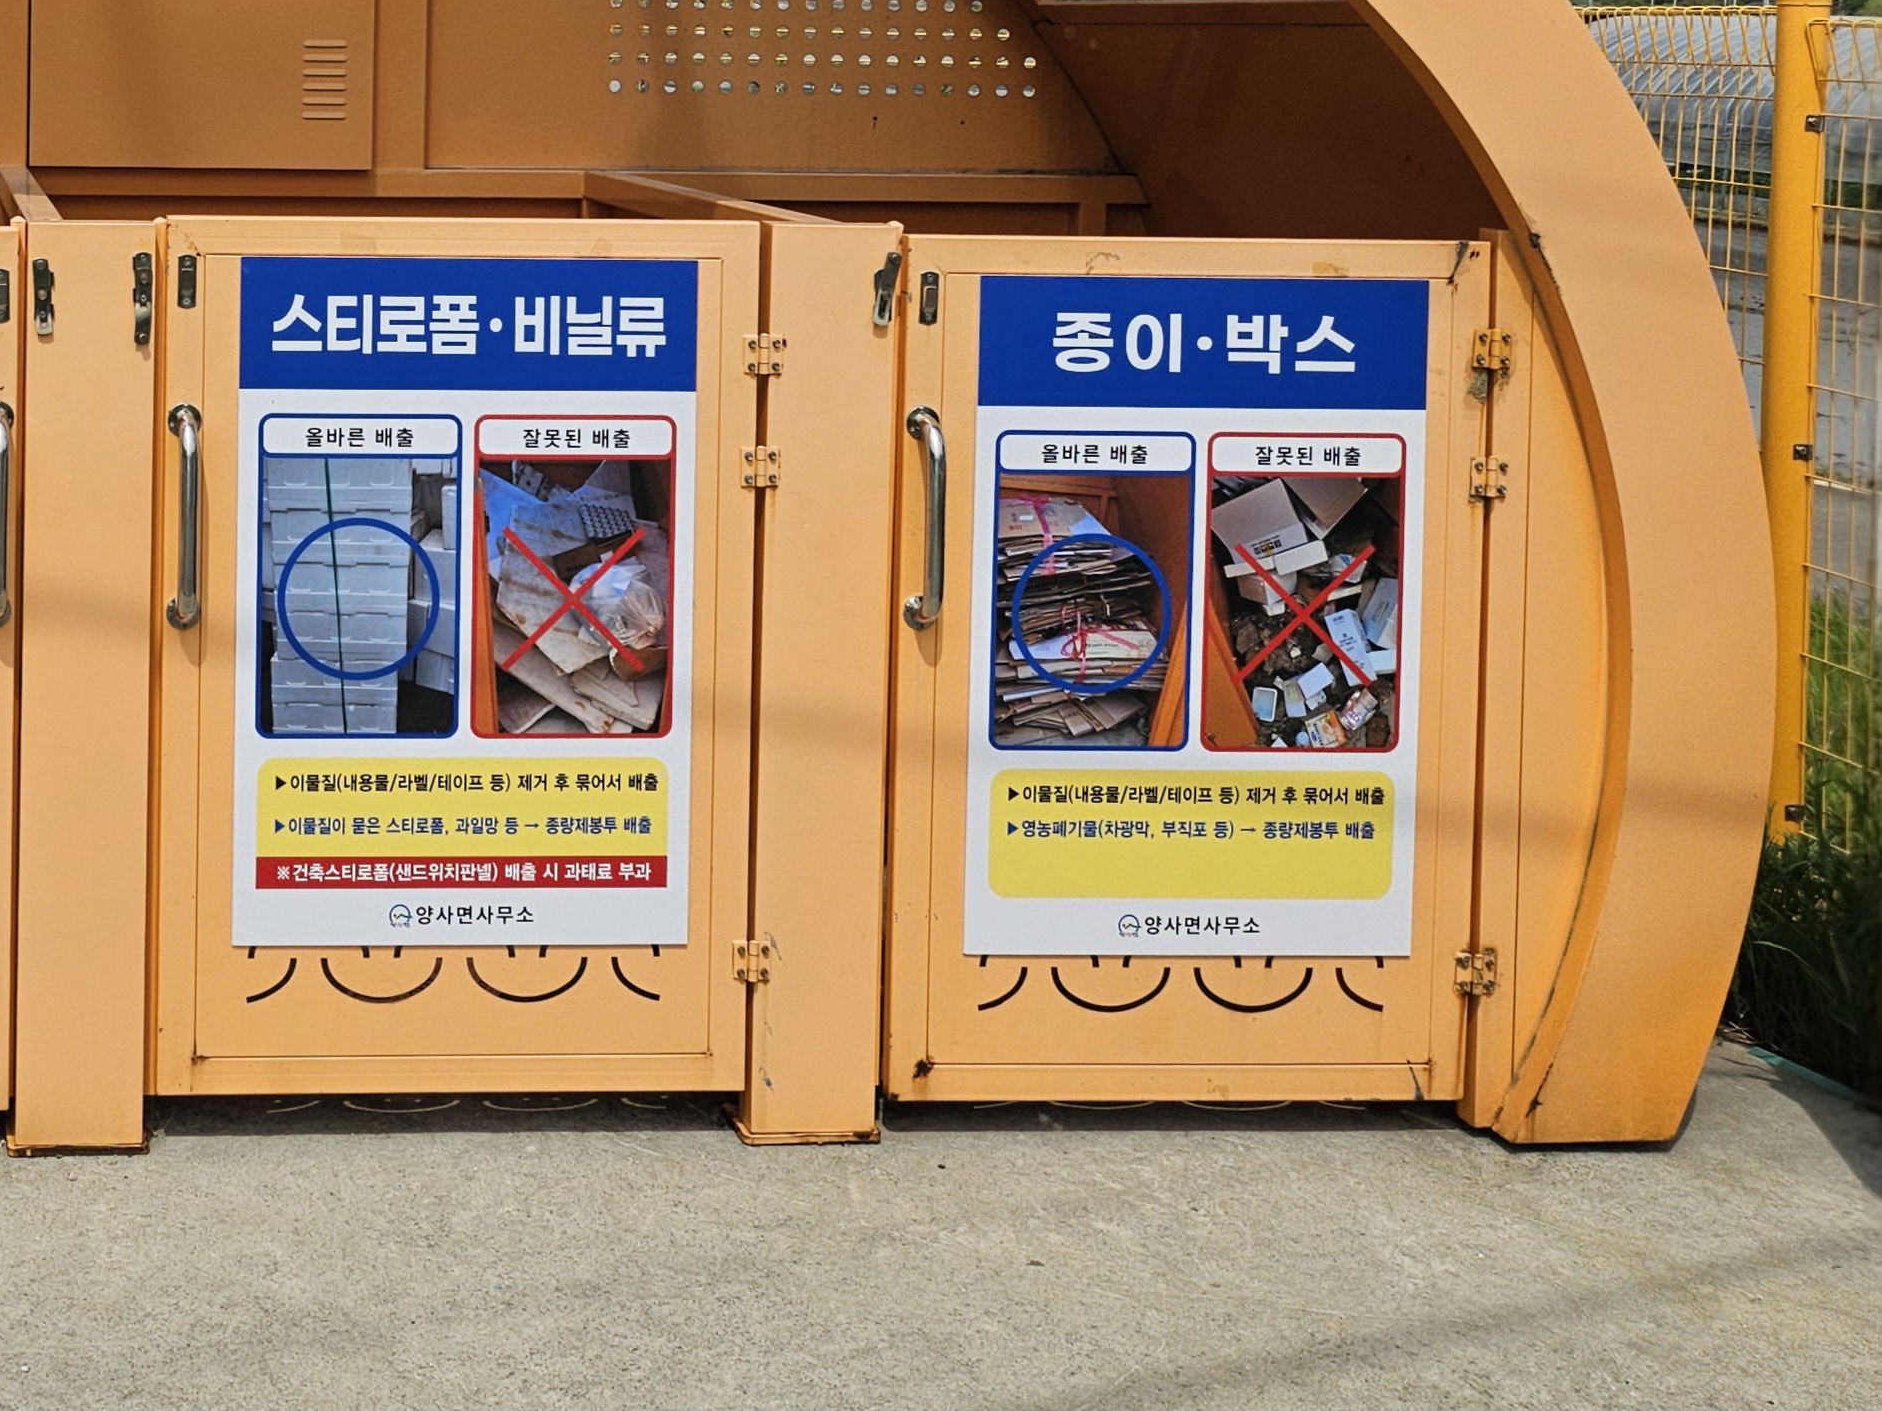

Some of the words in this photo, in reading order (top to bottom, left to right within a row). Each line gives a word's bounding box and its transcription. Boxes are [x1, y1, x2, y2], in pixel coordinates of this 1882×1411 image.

[306, 428, 365, 447] 올바른
[376, 428, 413, 447] 배출
[523, 429, 581, 448] 잘못된
[593, 429, 630, 448] 배출
[1042, 445, 1099, 464] 올바른
[1110, 445, 1147, 464] 배출
[1256, 446, 1312, 465] 잘못된
[1324, 447, 1360, 466] 배출
[490, 774, 510, 792] 등)
[518, 774, 547, 791] 제거
[554, 774, 569, 791] 후
[576, 774, 620, 791] 묶어서
[629, 773, 658, 791] 배출
[1219, 786, 1239, 805] 등)
[1246, 787, 1275, 804] 제거
[1282, 787, 1297, 804] 후
[1304, 788, 1348, 804] 묶어서
[1356, 787, 1384, 805] 배출
[289, 818, 345, 835] 이물질이
[352, 817, 380, 834] 묻은
[456, 817, 498, 834] 과일망
[505, 817, 518, 834] 등
[546, 817, 617, 834] 종량제봉투
[624, 816, 651, 834] 배출
[1162, 821, 1207, 838] 부직포
[1214, 822, 1234, 838] 등)
[1263, 822, 1338, 839] 종량제봉투
[1346, 822, 1375, 839] 배출
[505, 863, 536, 881] 배출
[543, 863, 558, 881] 시
[564, 863, 612, 881] 과태료
[619, 863, 651, 880] 부과
[416, 906, 533, 925] 양사면사무소
[1145, 916, 1260, 935] 양사면사무소
